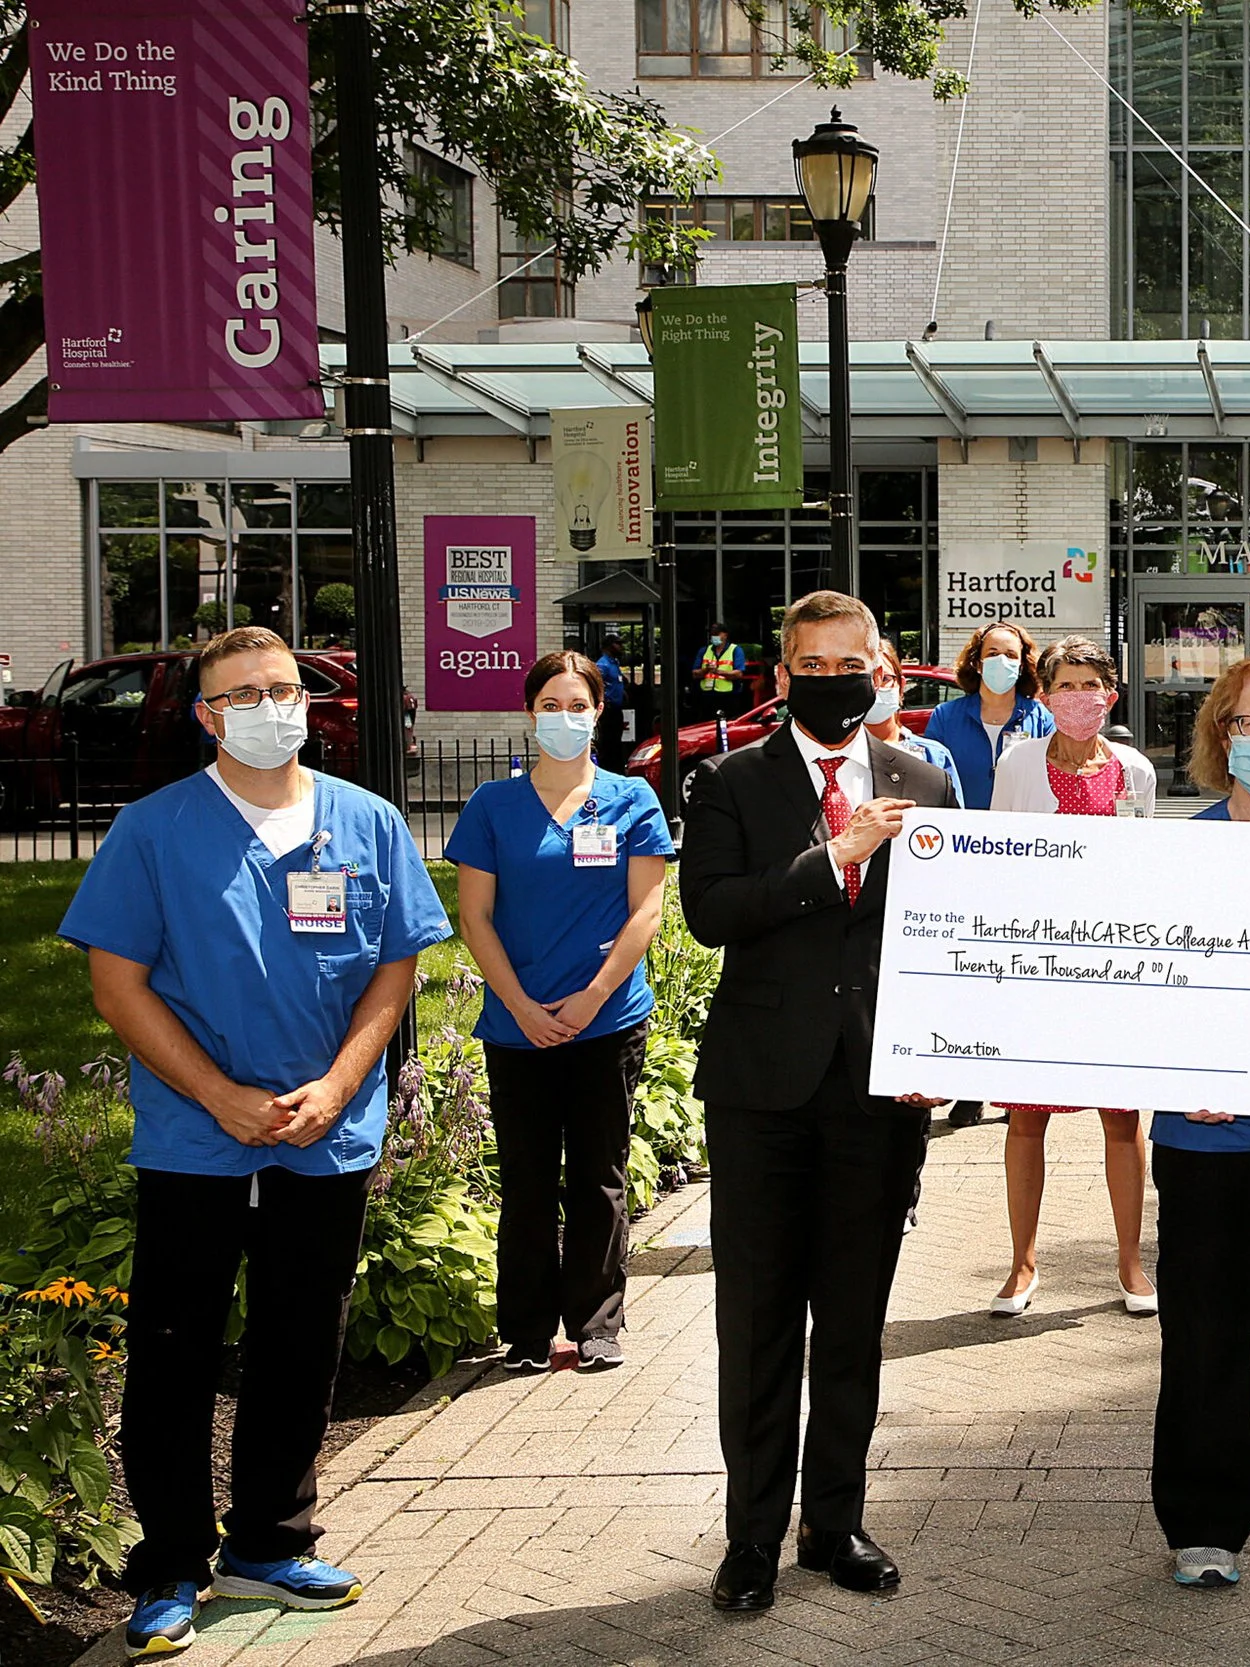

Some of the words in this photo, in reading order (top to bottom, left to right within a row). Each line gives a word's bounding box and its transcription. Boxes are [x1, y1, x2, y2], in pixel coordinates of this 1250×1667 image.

[46, 42, 86, 61] We
[94, 42, 128, 61] Do
[136, 40, 176, 61] the
[48, 70, 103, 91] Kind
[108, 69, 177, 96] Thing
[215, 96, 291, 369] Caring
[661, 315, 681, 326] We
[686, 314, 703, 325] Do
[707, 313, 727, 324] the
[62, 337, 107, 348] Hartford
[661, 329, 693, 344] Right
[695, 328, 730, 342] Thing
[62, 348, 107, 360] Hospital
[747, 322, 786, 483] Integrity
[622, 421, 641, 543] Innovation
[451, 550, 507, 569] BEST
[451, 570, 477, 583] REGIONAL
[478, 570, 508, 583] HOSPITALS
[947, 570, 1056, 592] Hartford
[947, 596, 1056, 623] Hospital
[440, 642, 522, 678] again
[294, 919, 342, 928] NURSE
[904, 910, 927, 924] Pay
[930, 911, 942, 922] to
[945, 912, 965, 923] the
[903, 926, 939, 938] Order
[942, 928, 955, 938] of
[972, 915, 1040, 941] Hartford
[1042, 918, 1161, 946] HealthCARES
[1165, 924, 1233, 958] Colleague
[947, 950, 1005, 983] Twenty
[1011, 954, 1039, 975] Five
[1038, 955, 1113, 980] Thousand
[1114, 960, 1145, 981] and
[892, 1044, 913, 1055] For
[931, 1032, 1001, 1056] Donation
